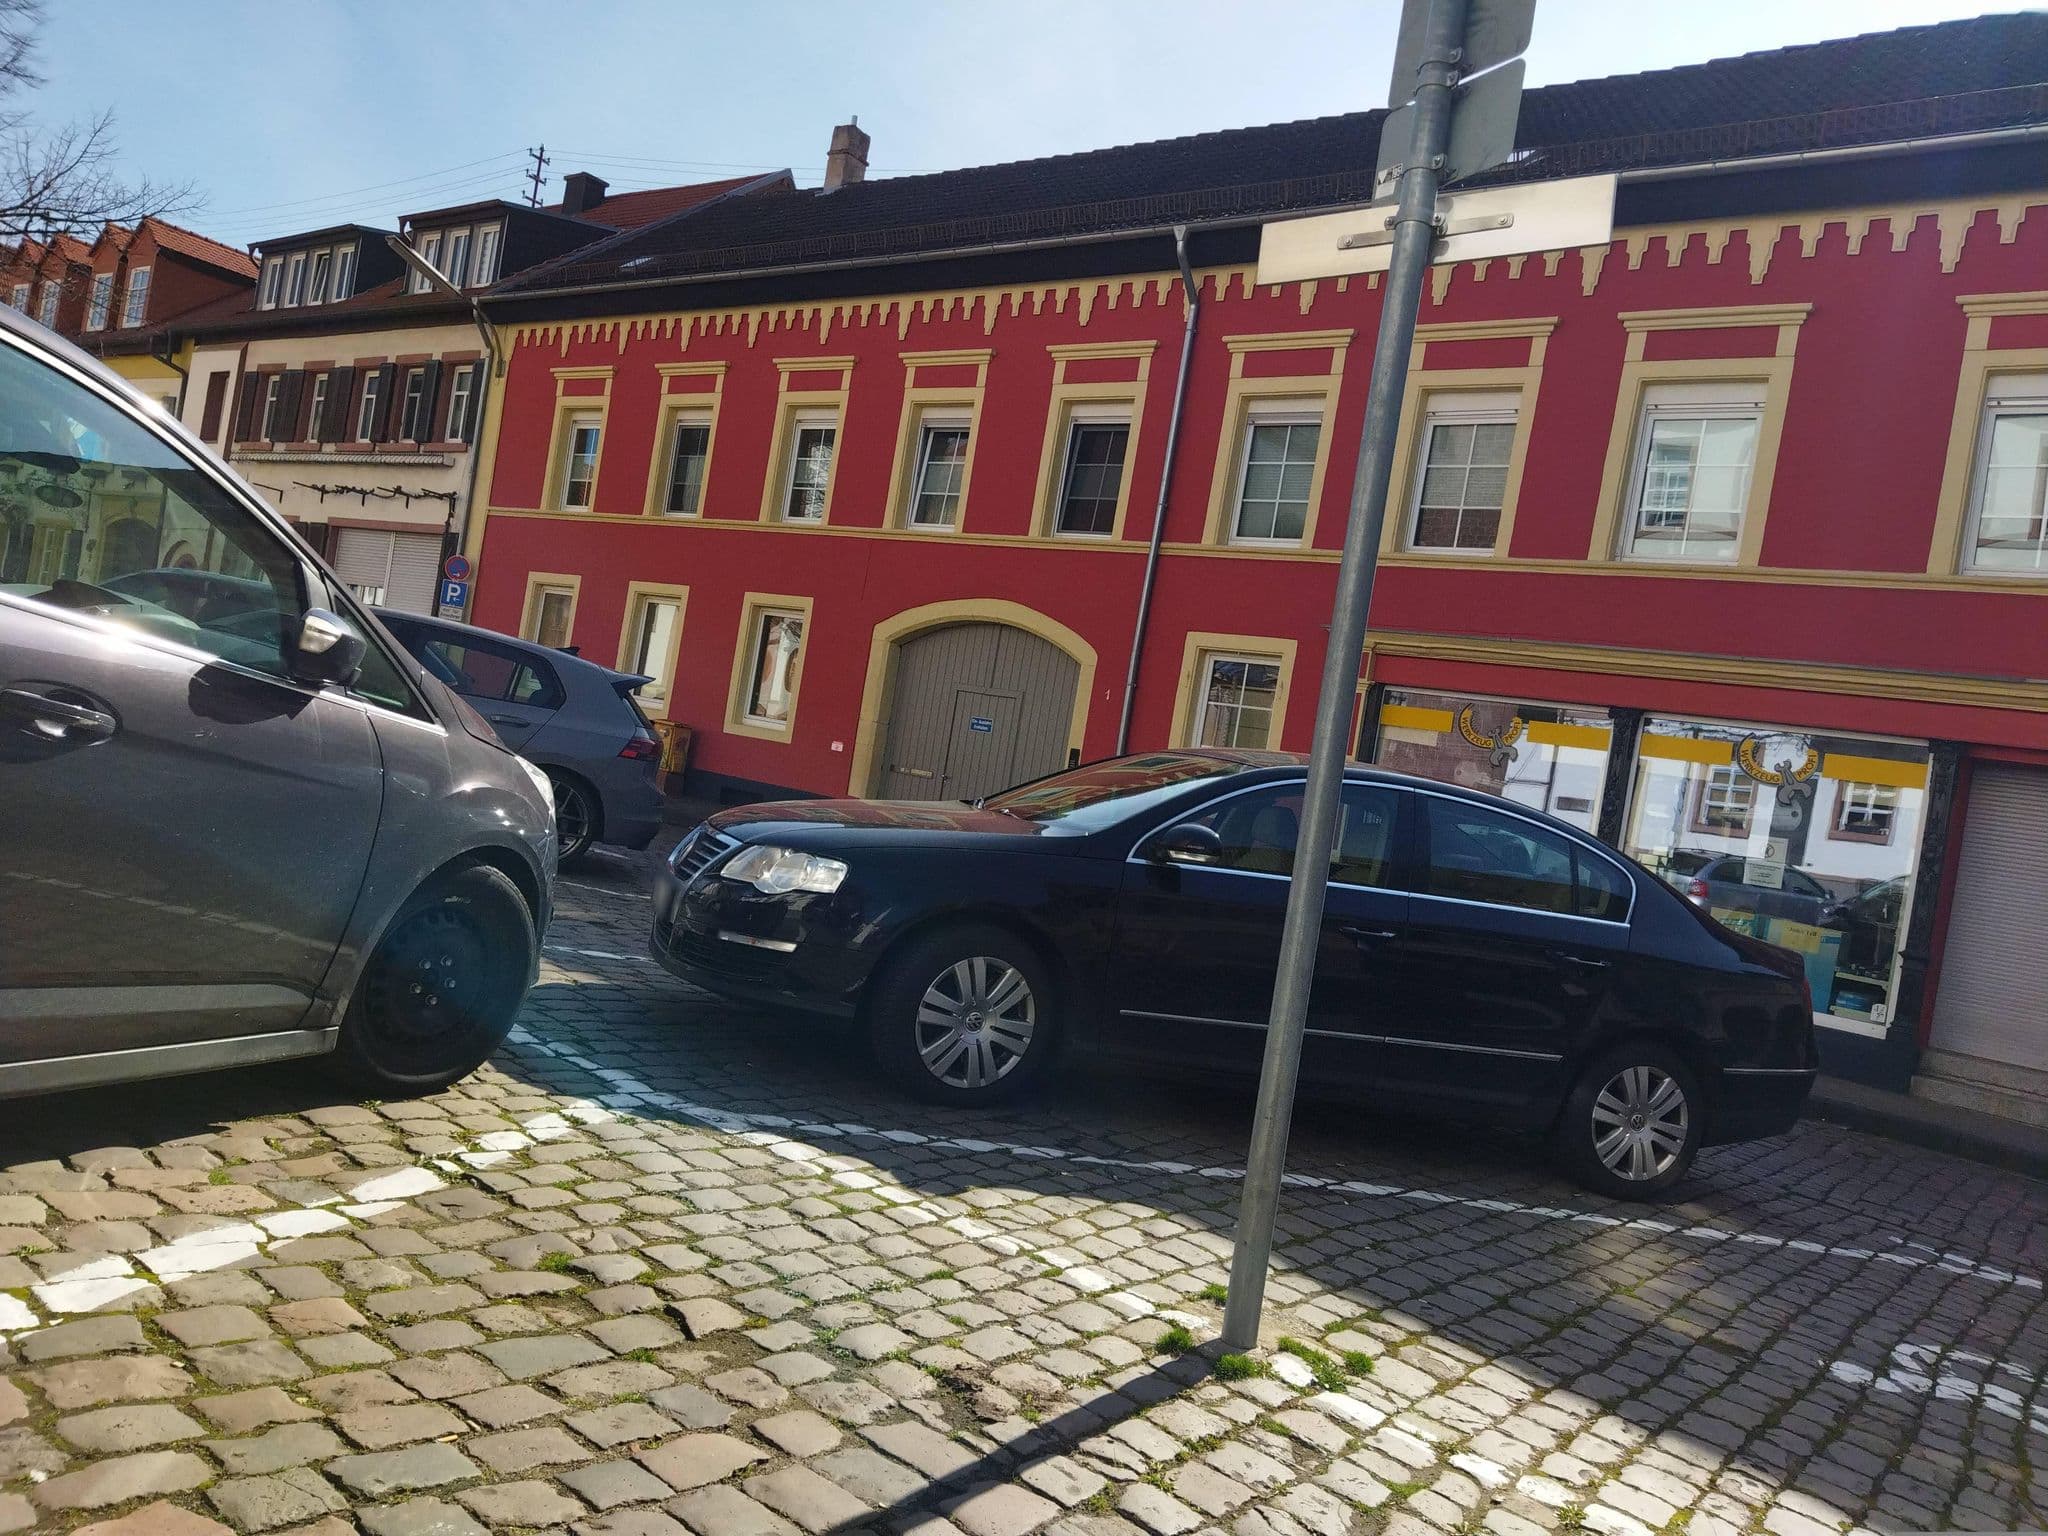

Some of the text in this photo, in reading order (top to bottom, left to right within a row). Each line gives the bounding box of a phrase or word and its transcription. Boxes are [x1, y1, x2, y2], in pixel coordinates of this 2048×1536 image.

[446, 583, 461, 602] P
[1462, 716, 1521, 747] WERKZEUG PROFI
[1741, 749, 1817, 782] WERKZEUG PROFI
